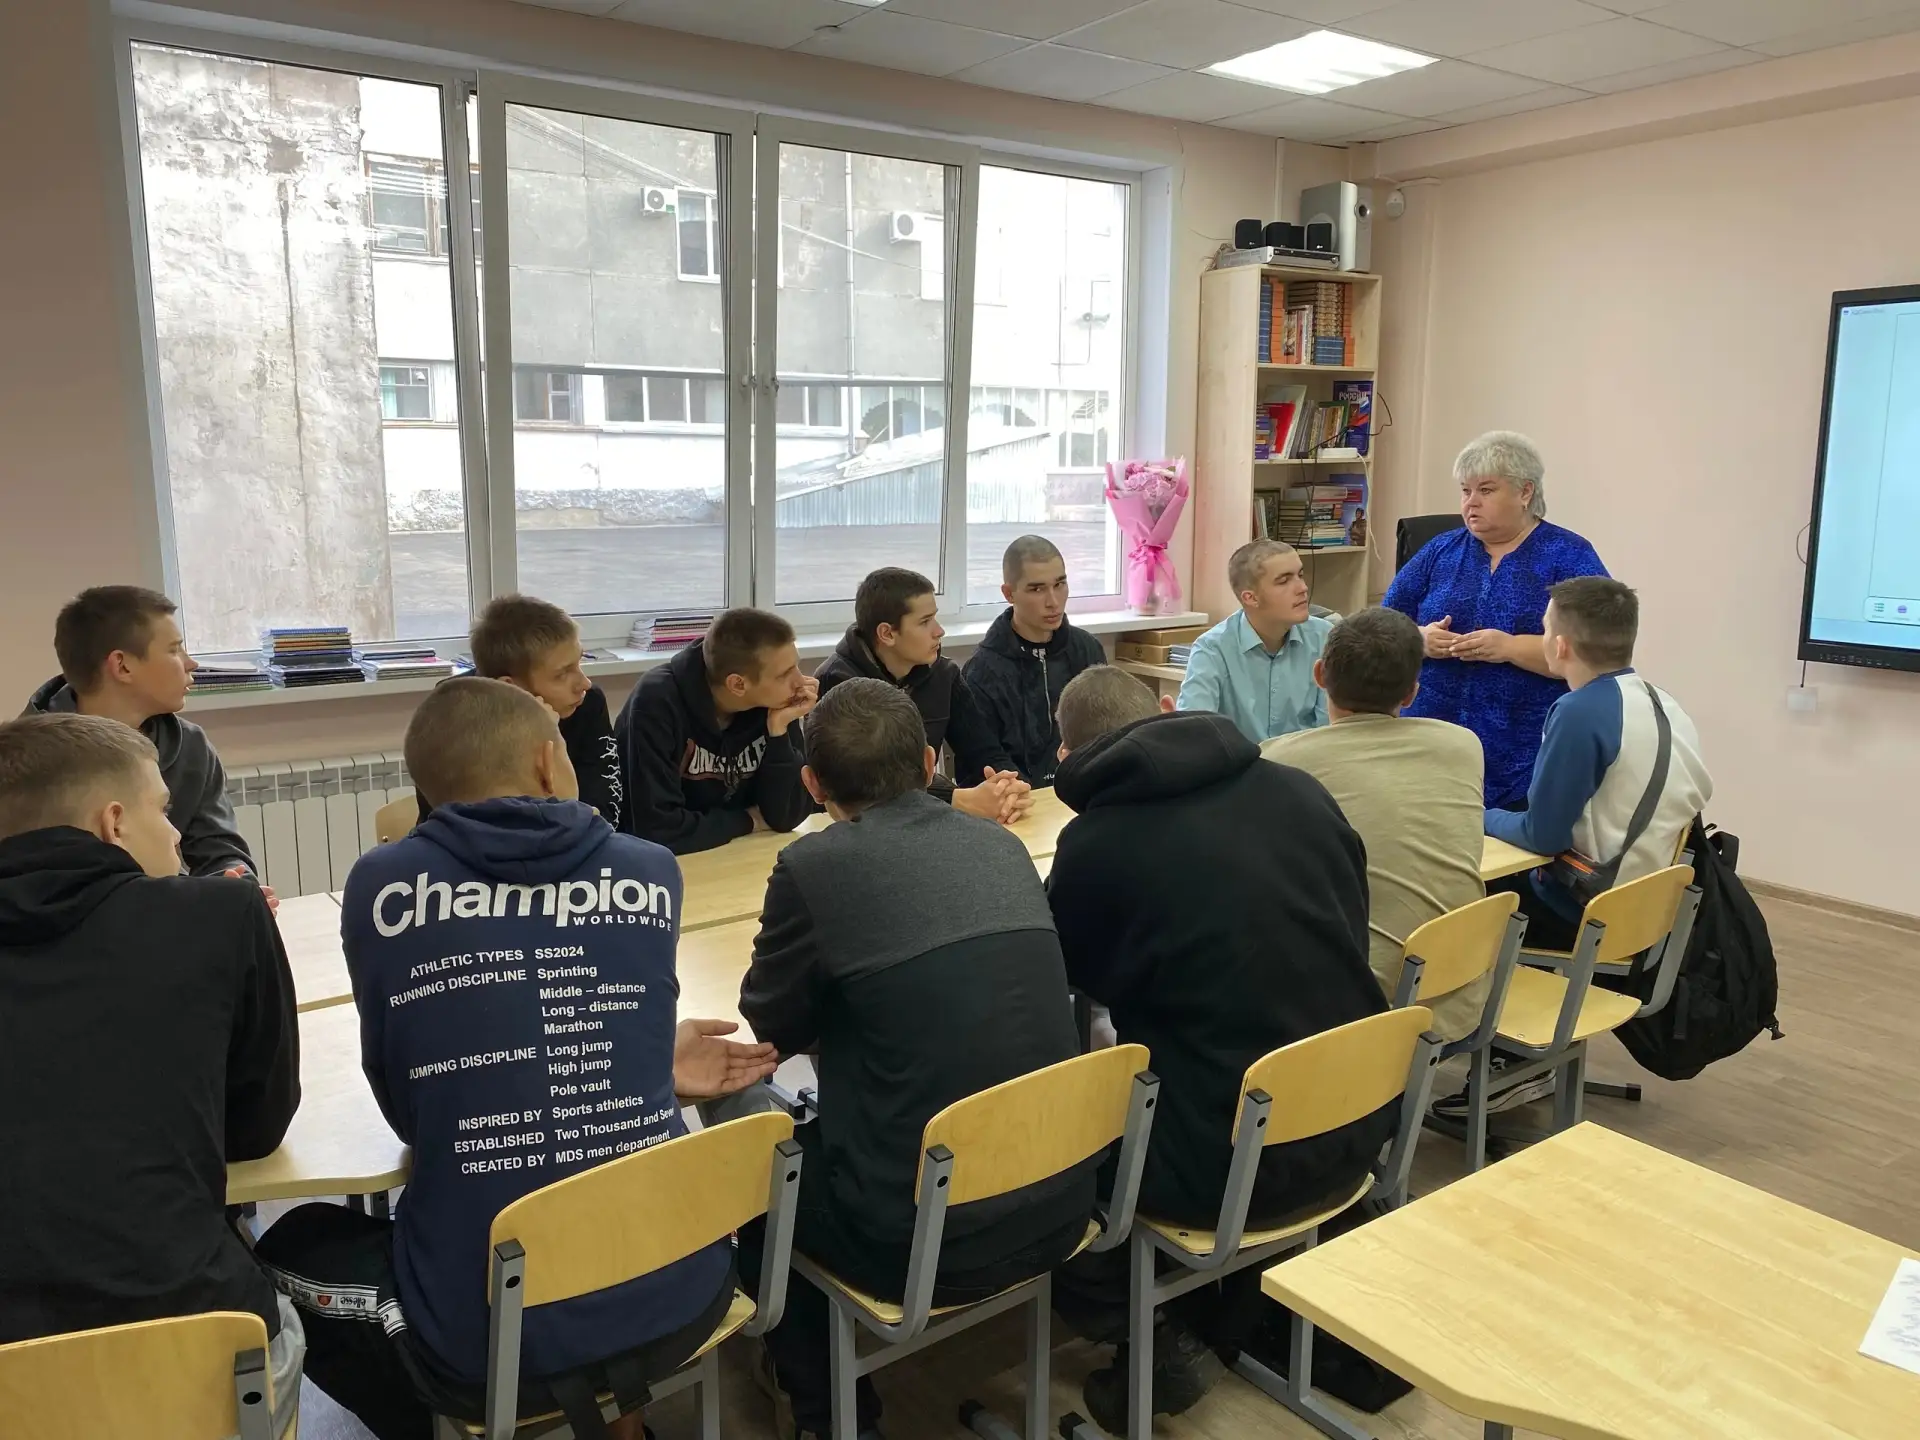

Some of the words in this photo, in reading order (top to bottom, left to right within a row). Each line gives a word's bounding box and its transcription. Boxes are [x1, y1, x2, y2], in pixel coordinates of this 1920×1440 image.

[372, 867, 672, 938] Champion
[573, 914, 672, 932] WORLDWIDE
[409, 954, 473, 980] ATHLETIC
[475, 949, 524, 963] TYPES
[534, 945, 585, 960] SS2024
[389, 981, 446, 1008] RUNNING
[447, 969, 528, 991] DISCIPLINE
[537, 964, 598, 980] Sprinting
[539, 985, 583, 1001] Middle
[597, 982, 646, 997] distance
[541, 1005, 575, 1018] Long
[589, 1000, 640, 1014] distance
[544, 1019, 604, 1035] Marathon
[409, 1059, 458, 1080] JUMPING
[459, 1046, 538, 1070] DISCIPLINE
[546, 1044, 579, 1059] Long
[581, 1040, 613, 1056] jump
[548, 1060, 578, 1077] High
[580, 1058, 612, 1075] jump
[549, 1082, 578, 1098] Pole
[580, 1078, 612, 1095] vault
[458, 1112, 520, 1131] INSPIRED
[523, 1108, 543, 1123] BY
[552, 1104, 593, 1122] Sports
[595, 1095, 644, 1112] athletics
[454, 1132, 545, 1154] ESTABLISHED
[555, 1128, 580, 1142] Two
[582, 1115, 641, 1137] Thousand
[643, 1111, 660, 1126] and
[461, 1156, 523, 1175] CREATED
[527, 1154, 548, 1169] BY
[555, 1148, 586, 1165] MDS
[586, 1145, 613, 1159] men
[615, 1129, 671, 1153] department
